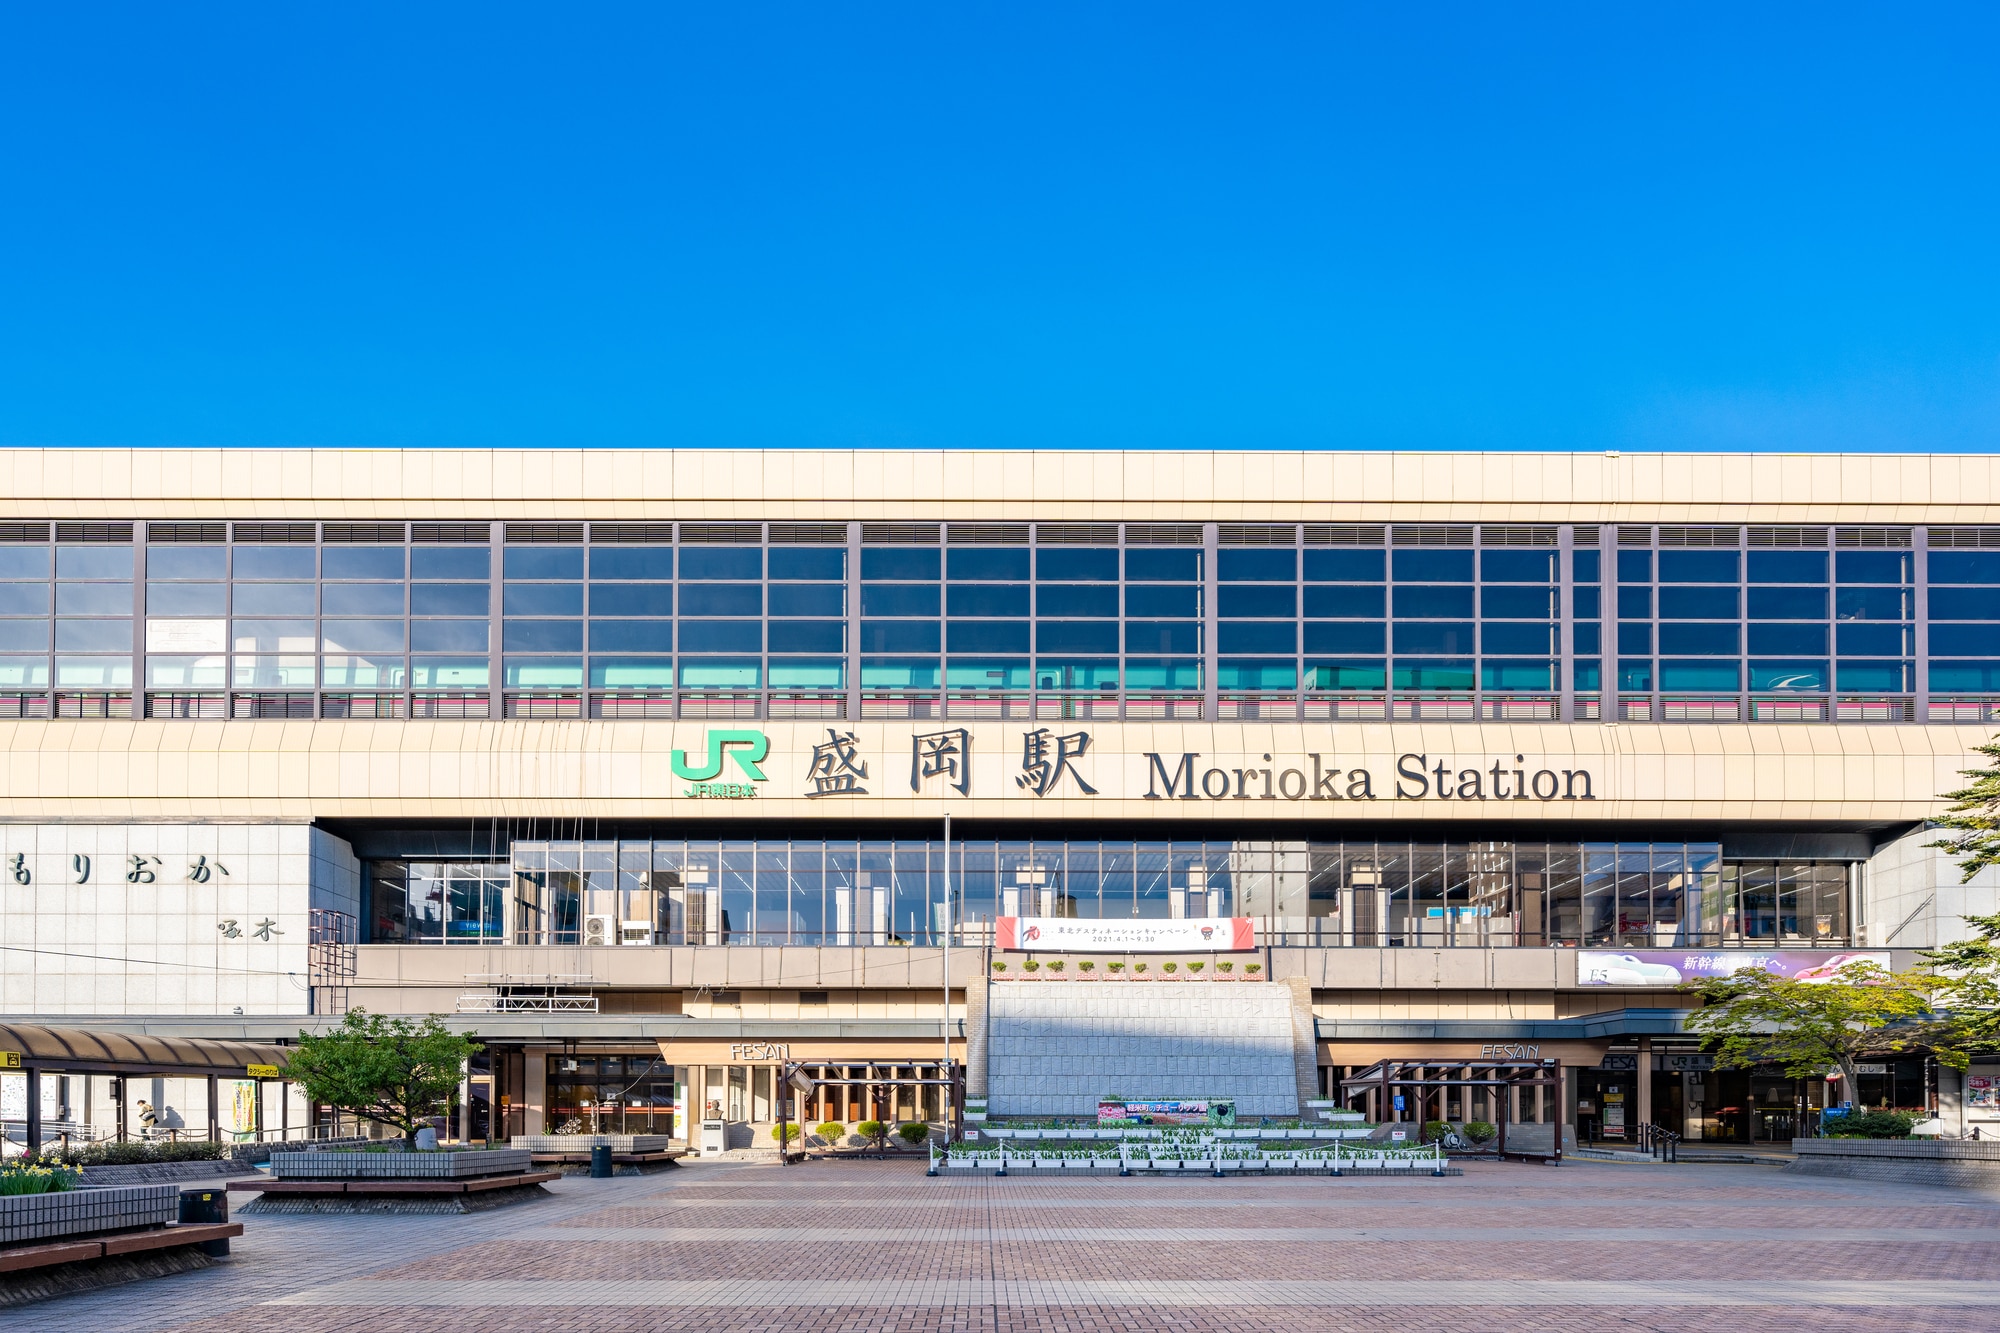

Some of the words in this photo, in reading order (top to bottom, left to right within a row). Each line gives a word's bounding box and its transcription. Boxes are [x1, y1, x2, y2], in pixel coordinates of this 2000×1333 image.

[671, 730, 768, 781] JR
[805, 728, 1097, 799] 盛岡駅
[1143, 752, 1376, 799] Morioka
[1397, 753, 1596, 800] Station
[683, 783, 757, 798] JR東日本
[9, 852, 229, 885] もりおか
[1058, 927, 1189, 935] 東北デスティネーションキャンペーン
[1590, 968, 1607, 982] E5
[1672, 1057, 1687, 1066] JR
